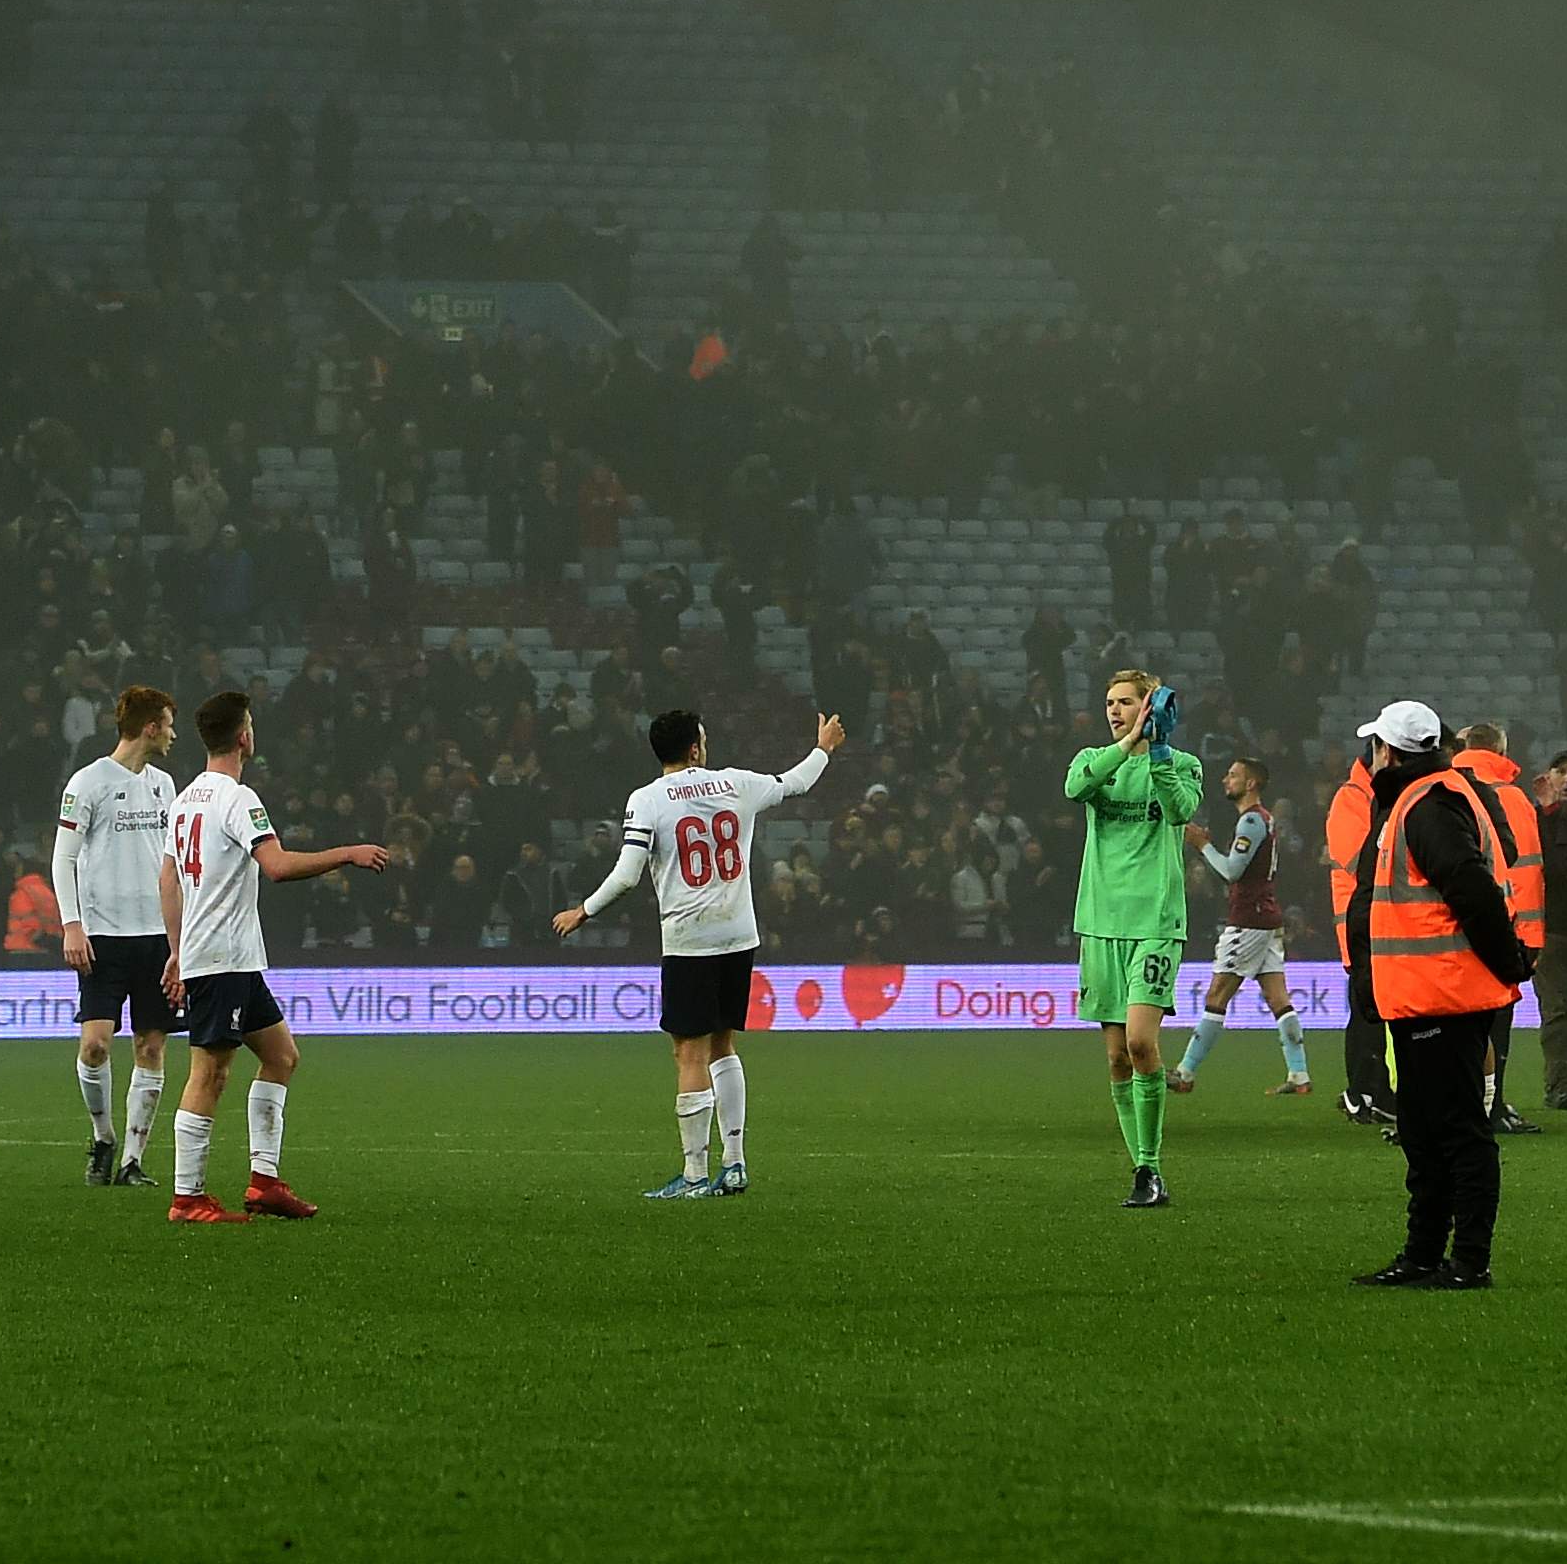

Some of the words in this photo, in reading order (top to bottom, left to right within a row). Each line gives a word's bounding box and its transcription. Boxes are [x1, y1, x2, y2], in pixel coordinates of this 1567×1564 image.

[667, 780, 734, 802] CHIRIVELLA
[114, 821, 159, 833] Chartered
[117, 810, 158, 821] Standard
[674, 809, 745, 889] 68
[1143, 953, 1172, 988] 62
[326, 985, 411, 1022] Villa
[429, 983, 597, 1022] Football
[935, 981, 1056, 1026] Doing
